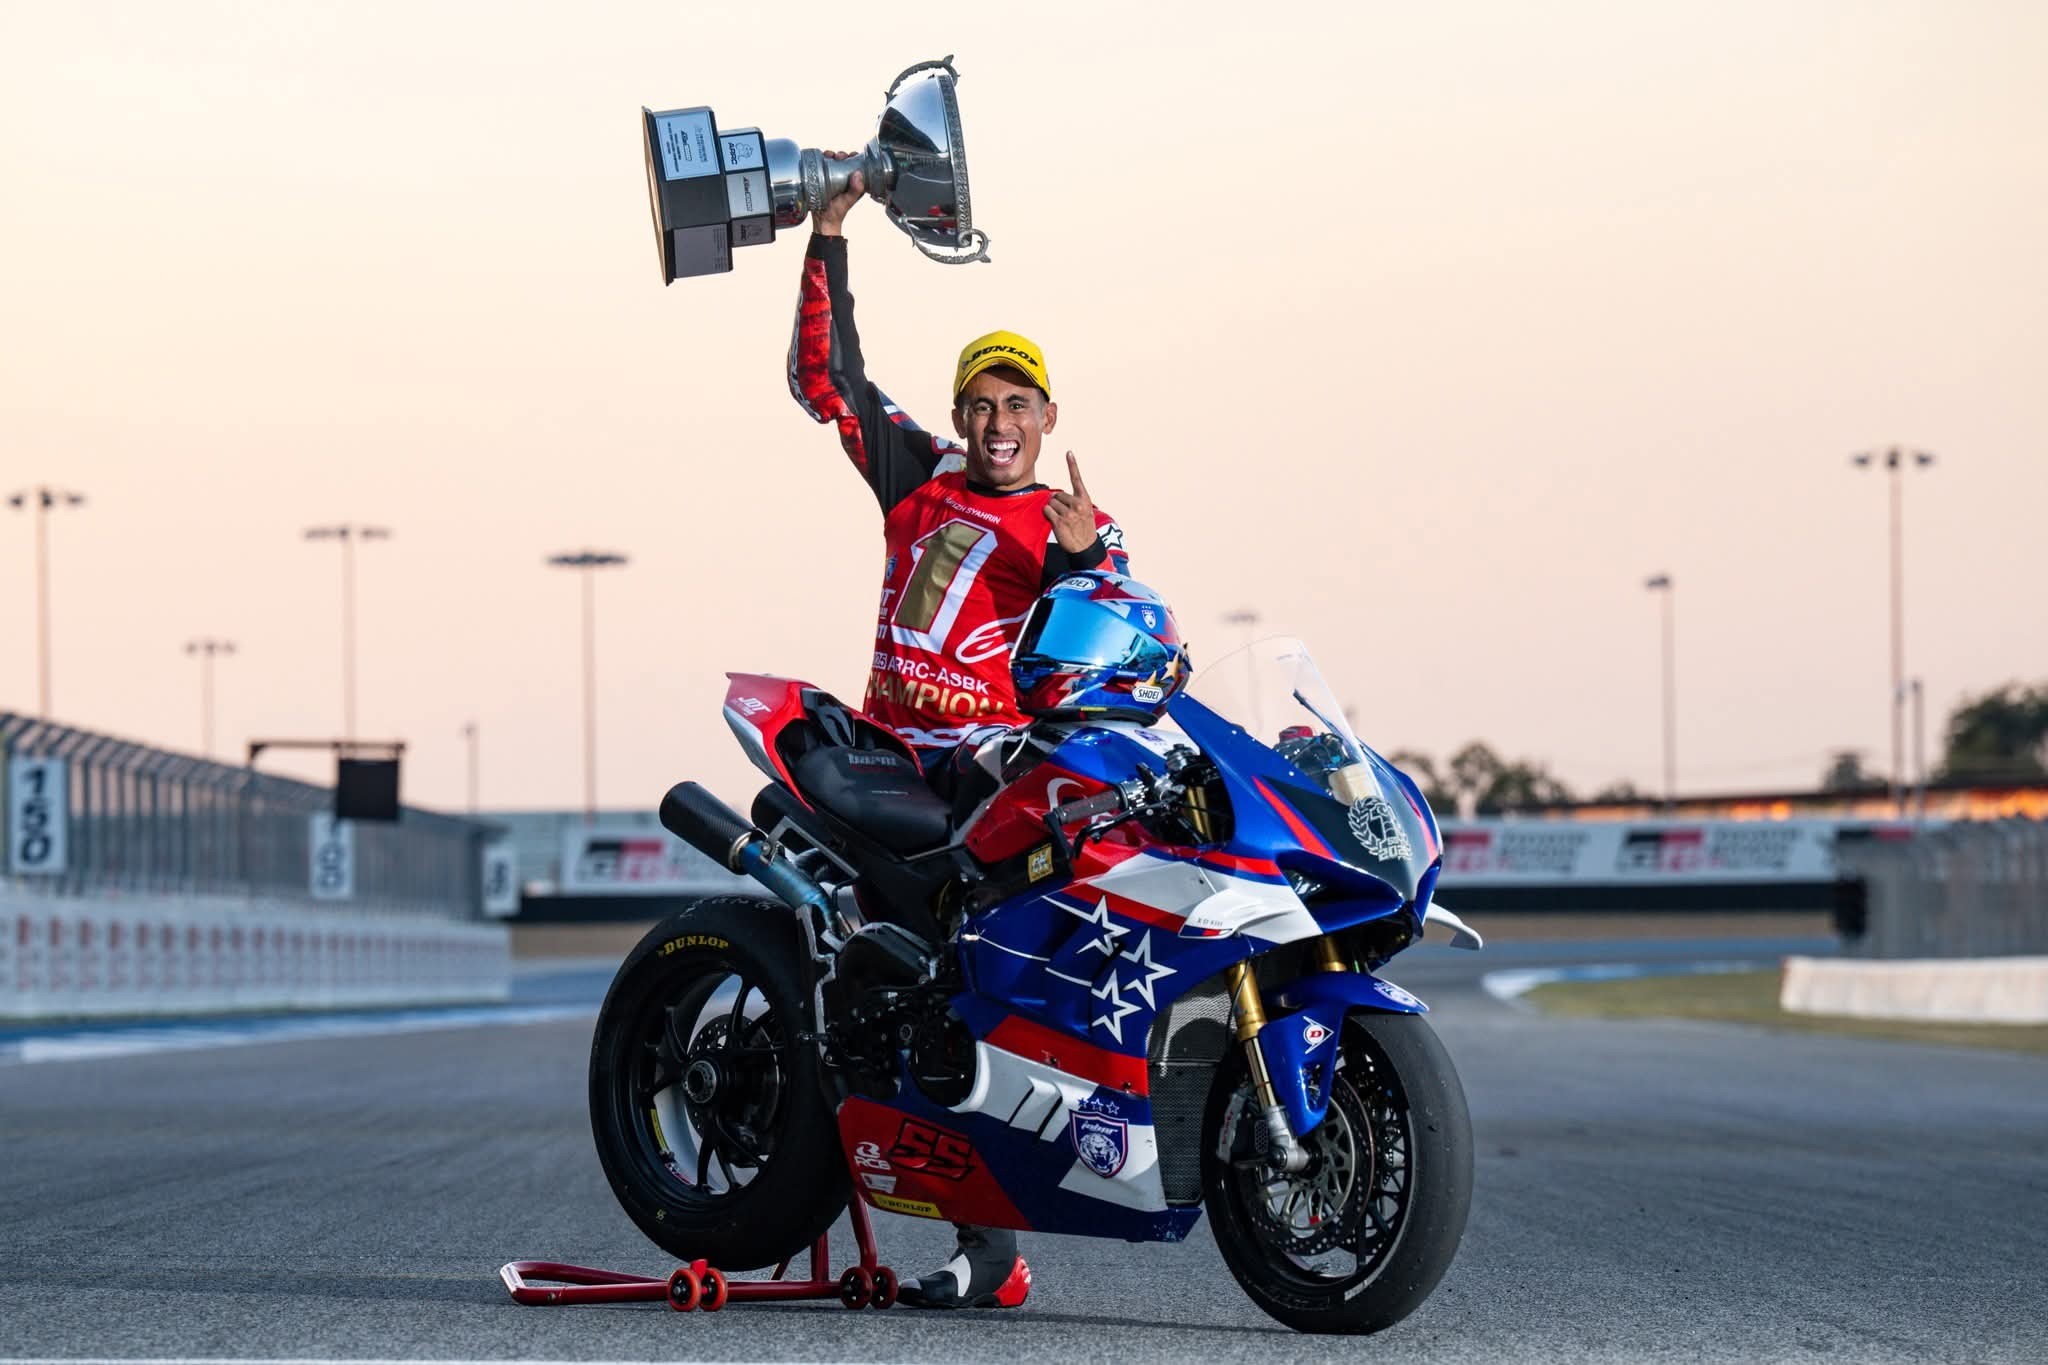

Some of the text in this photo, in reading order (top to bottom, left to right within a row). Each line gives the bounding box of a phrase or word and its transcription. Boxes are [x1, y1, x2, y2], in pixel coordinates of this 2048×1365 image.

[972, 345, 1038, 367] DUNLOP
[965, 507, 1001, 525] SYAHRIN
[1138, 688, 1160, 700] SHOEI
[21, 768, 51, 864] 150
[664, 935, 729, 955] DUNLOP
